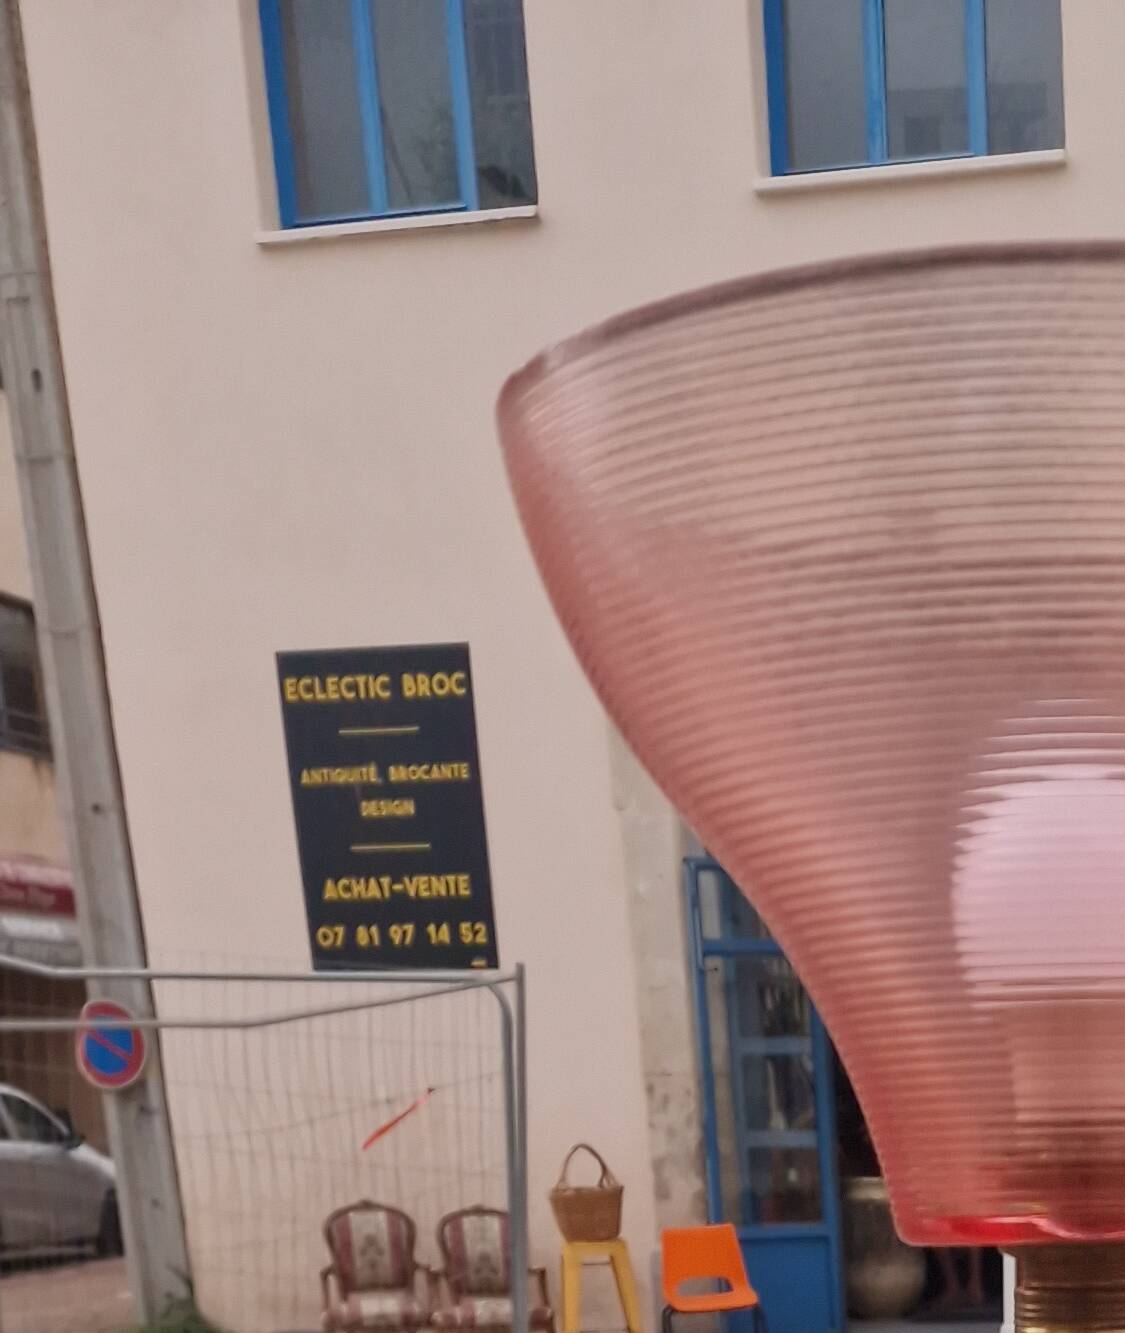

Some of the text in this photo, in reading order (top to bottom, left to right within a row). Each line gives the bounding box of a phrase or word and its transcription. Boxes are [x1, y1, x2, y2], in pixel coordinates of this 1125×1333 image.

[284, 671, 466, 702] ECLECTIC BROC
[388, 762, 470, 783] BROCANTE
[360, 800, 416, 817] DESIGN
[324, 874, 471, 900] ACHAT-VENTE
[316, 921, 488, 947] 07 81 97 14 52
